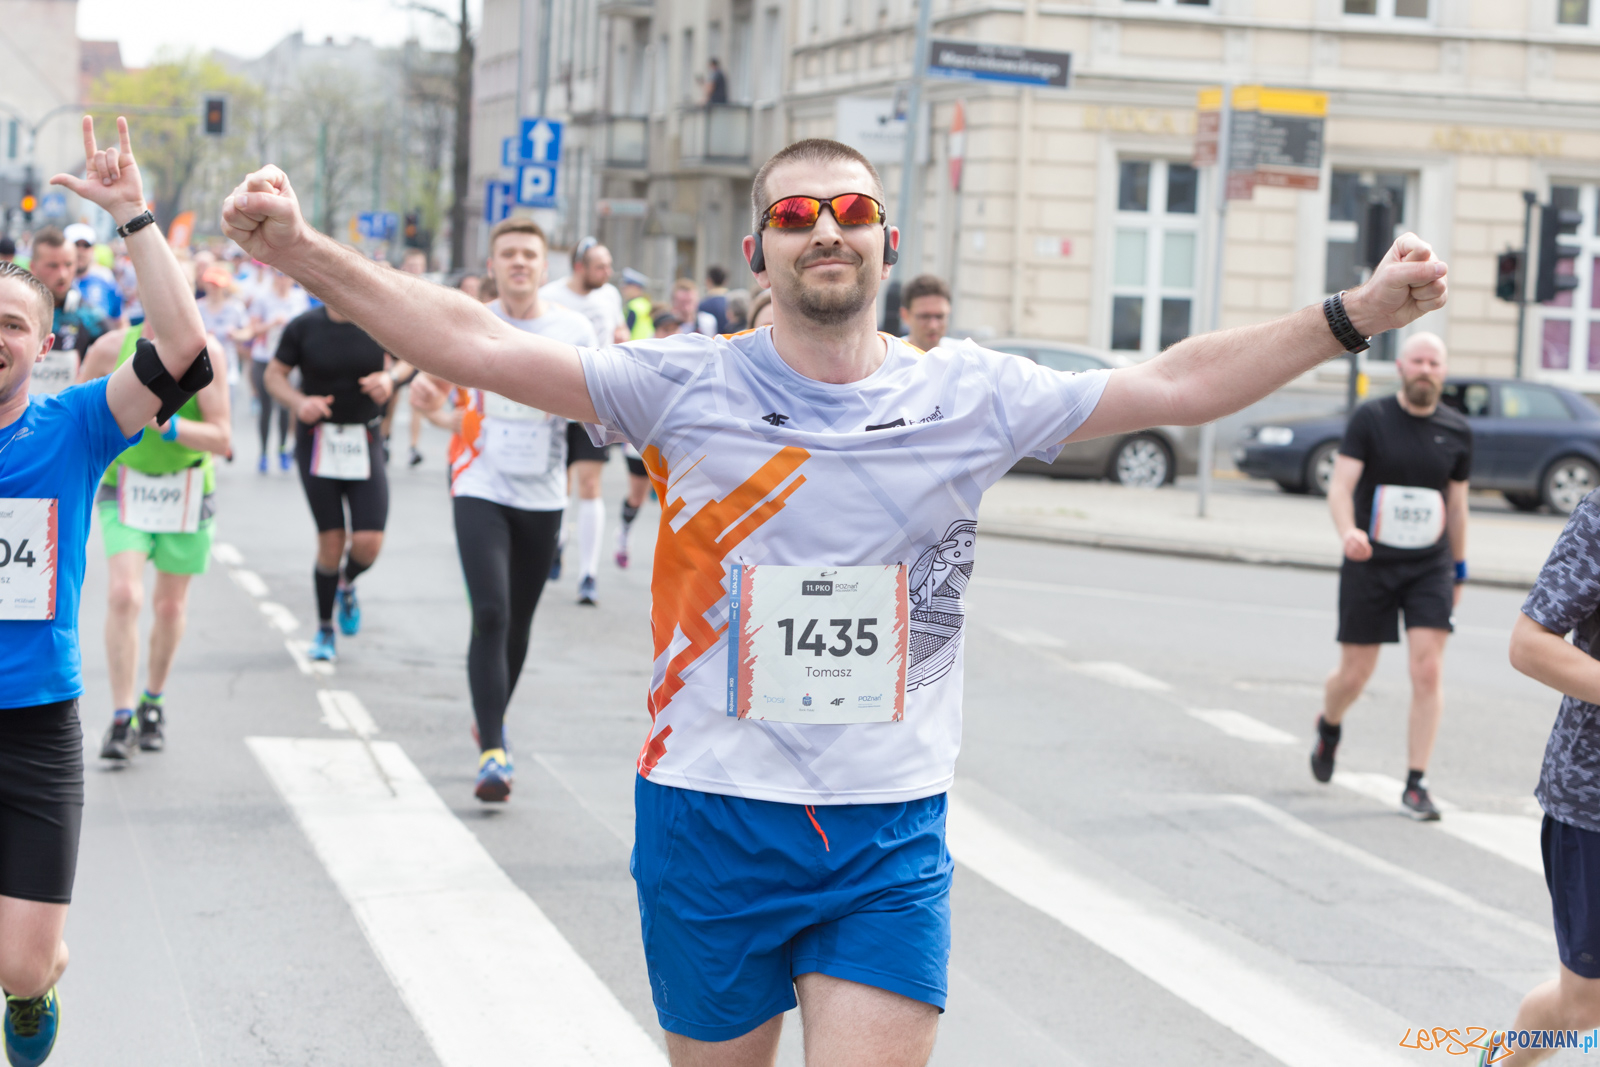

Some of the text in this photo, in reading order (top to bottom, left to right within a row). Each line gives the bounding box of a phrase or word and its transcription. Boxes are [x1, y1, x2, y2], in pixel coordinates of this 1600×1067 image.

[130, 485, 182, 504] 11499
[1394, 506, 1432, 523] 1857
[777, 617, 879, 657] 1435
[804, 666, 853, 678] Tomasz
